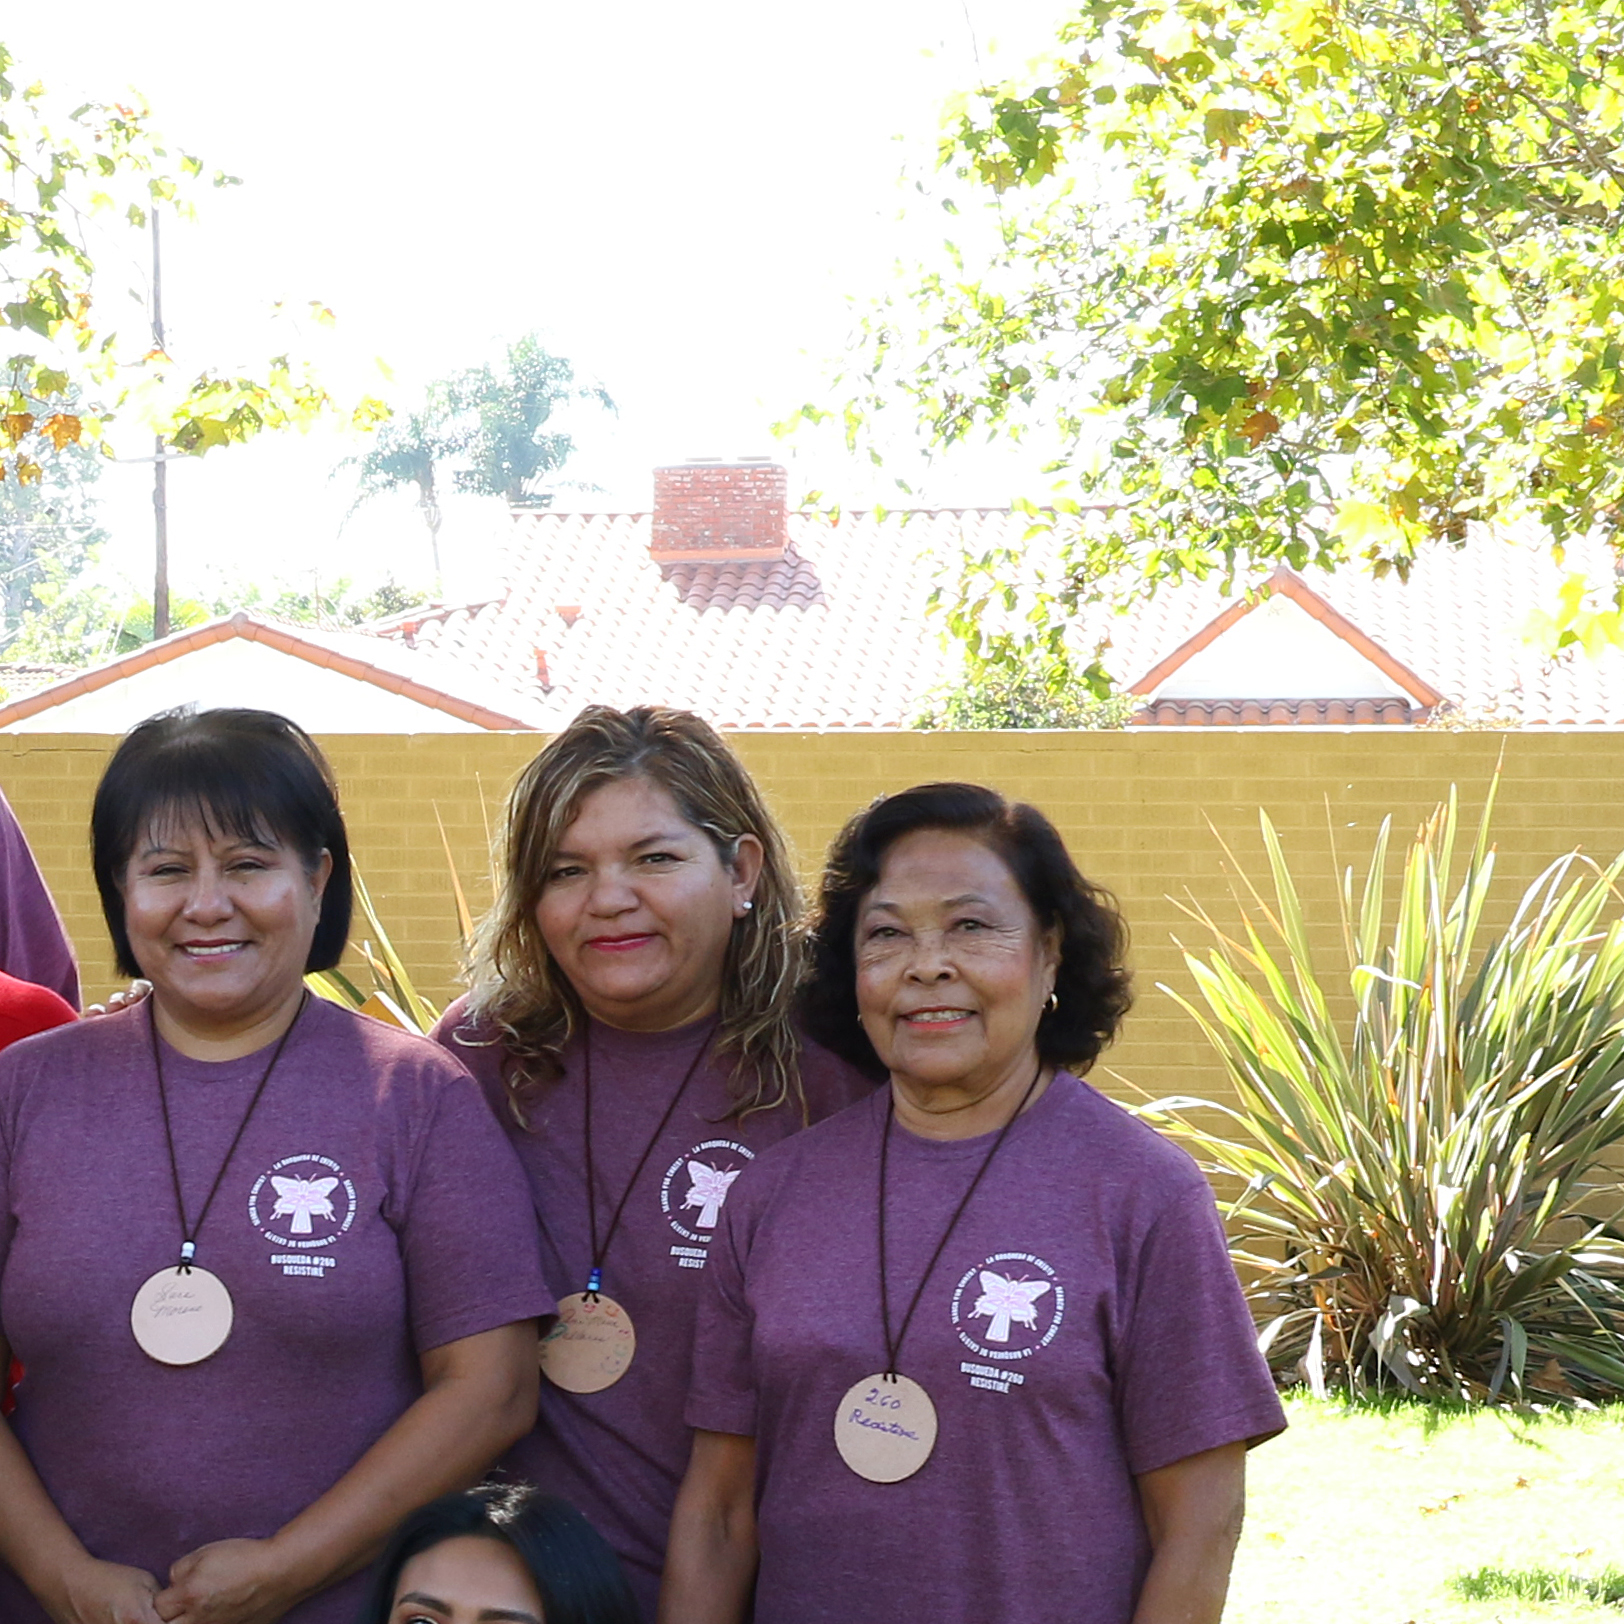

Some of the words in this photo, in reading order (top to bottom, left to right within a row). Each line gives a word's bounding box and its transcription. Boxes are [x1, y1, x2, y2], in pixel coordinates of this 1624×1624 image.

[670, 1245, 707, 1258] BUSQUEDA
[270, 1254, 312, 1265] BUSQUEDA
[678, 1257, 706, 1270] RESIST
[985, 1256, 995, 1265] LA
[994, 1252, 1027, 1261] BUSQUEDA
[1026, 1254, 1036, 1263] DE
[960, 1361, 1000, 1379] BUSQUEDA
[1000, 1370, 1025, 1385] #260
[864, 1388, 901, 1409] 260
